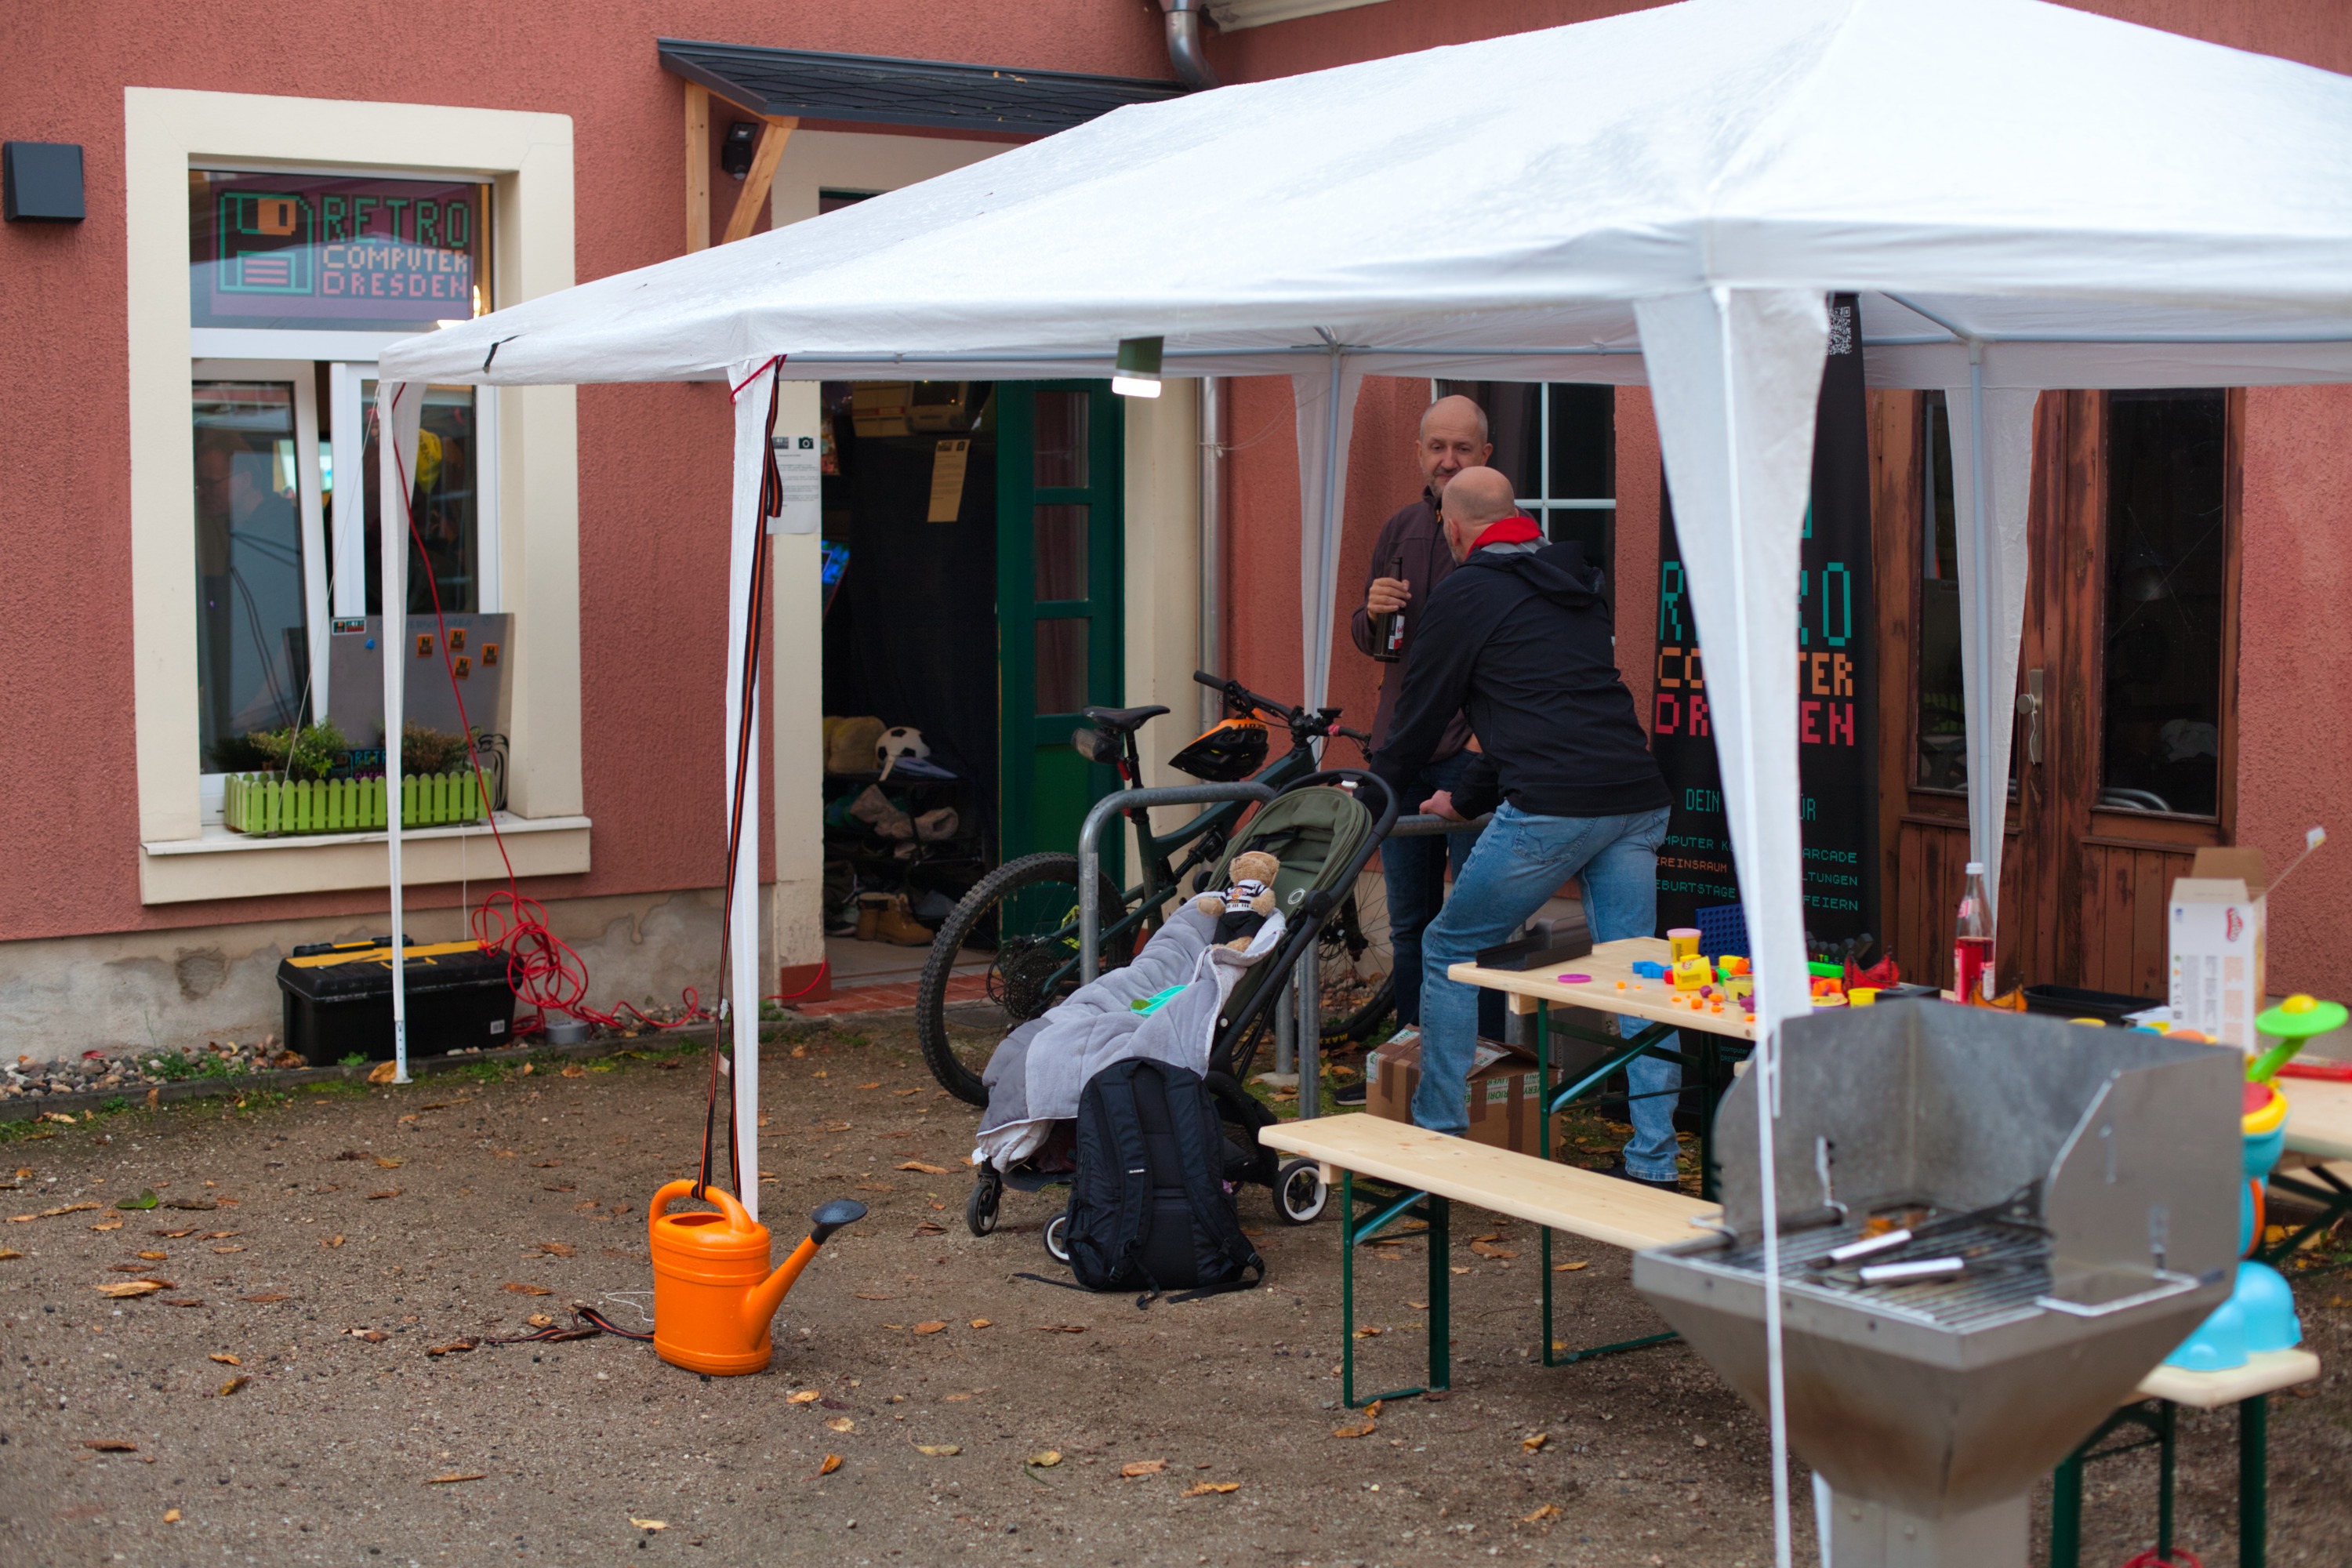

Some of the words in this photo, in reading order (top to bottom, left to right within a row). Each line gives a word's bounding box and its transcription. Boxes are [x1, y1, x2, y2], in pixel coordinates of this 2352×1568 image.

[323, 197, 468, 246] RETRO
[322, 245, 468, 273] COMPUTER
[322, 270, 468, 298] DRESDEN
[1654, 694, 1854, 746] DREN
[354, 750, 387, 766] RETR
[1685, 787, 1720, 813] DEIN
[1663, 835, 1714, 850] MPUTER
[1802, 848, 1857, 864] ARCADE
[1656, 856, 1728, 873] EREINSRAUM
[1656, 879, 1736, 899] EBURTSTAGE
